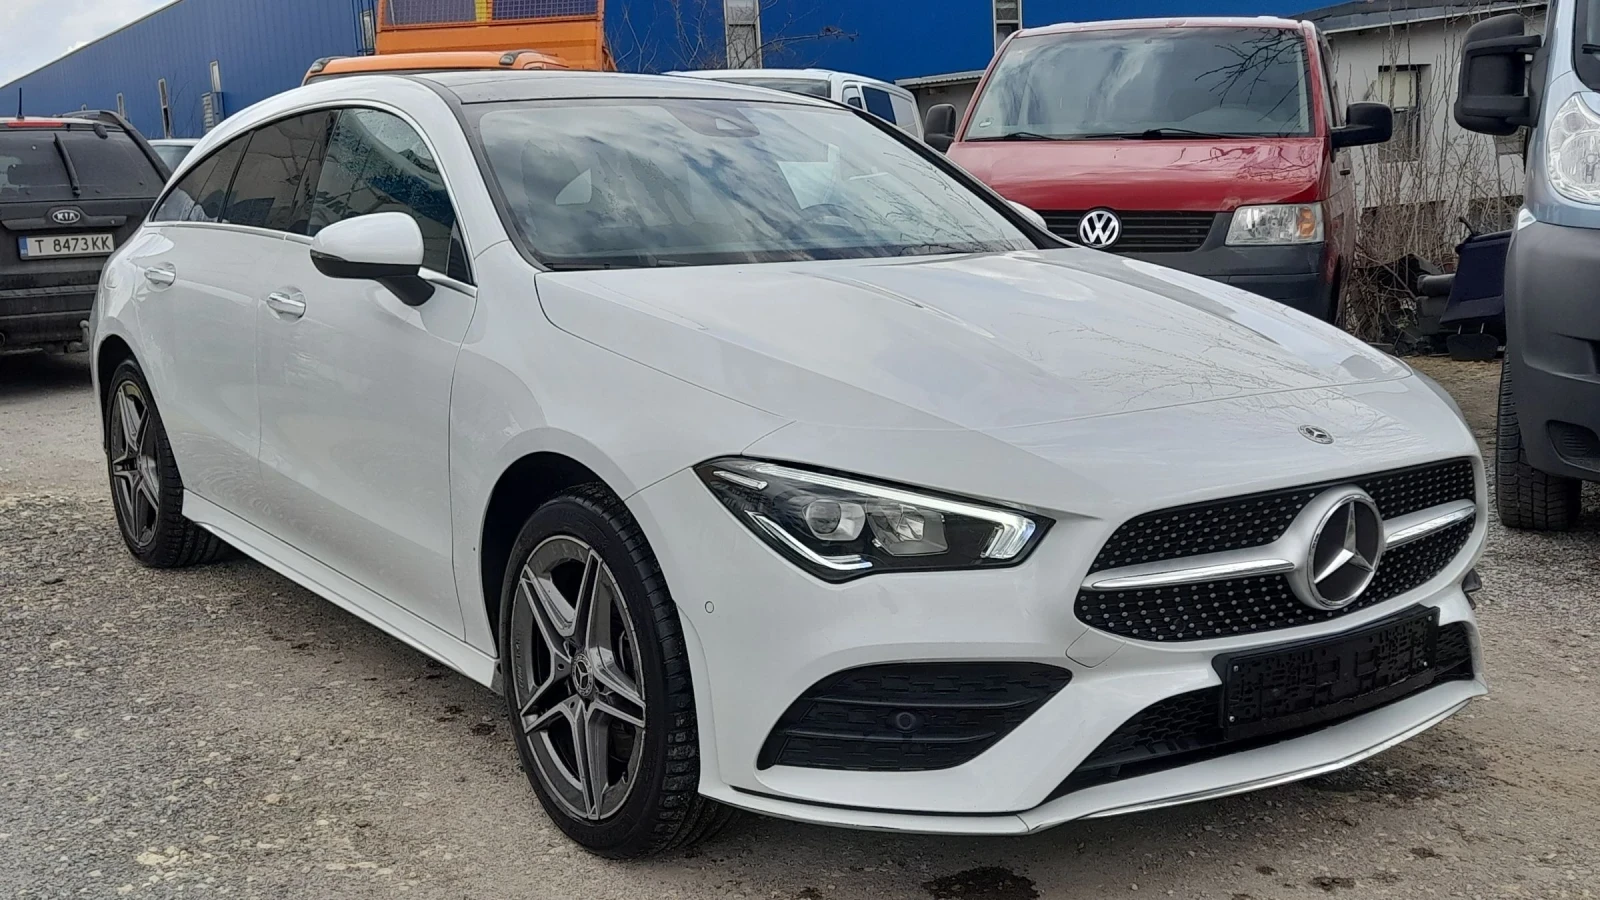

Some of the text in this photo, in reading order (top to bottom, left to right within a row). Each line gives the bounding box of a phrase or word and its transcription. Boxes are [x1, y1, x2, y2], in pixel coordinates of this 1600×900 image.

[57, 212, 76, 221] KIA
[1080, 211, 1119, 248] VW
[34, 239, 44, 253] T
